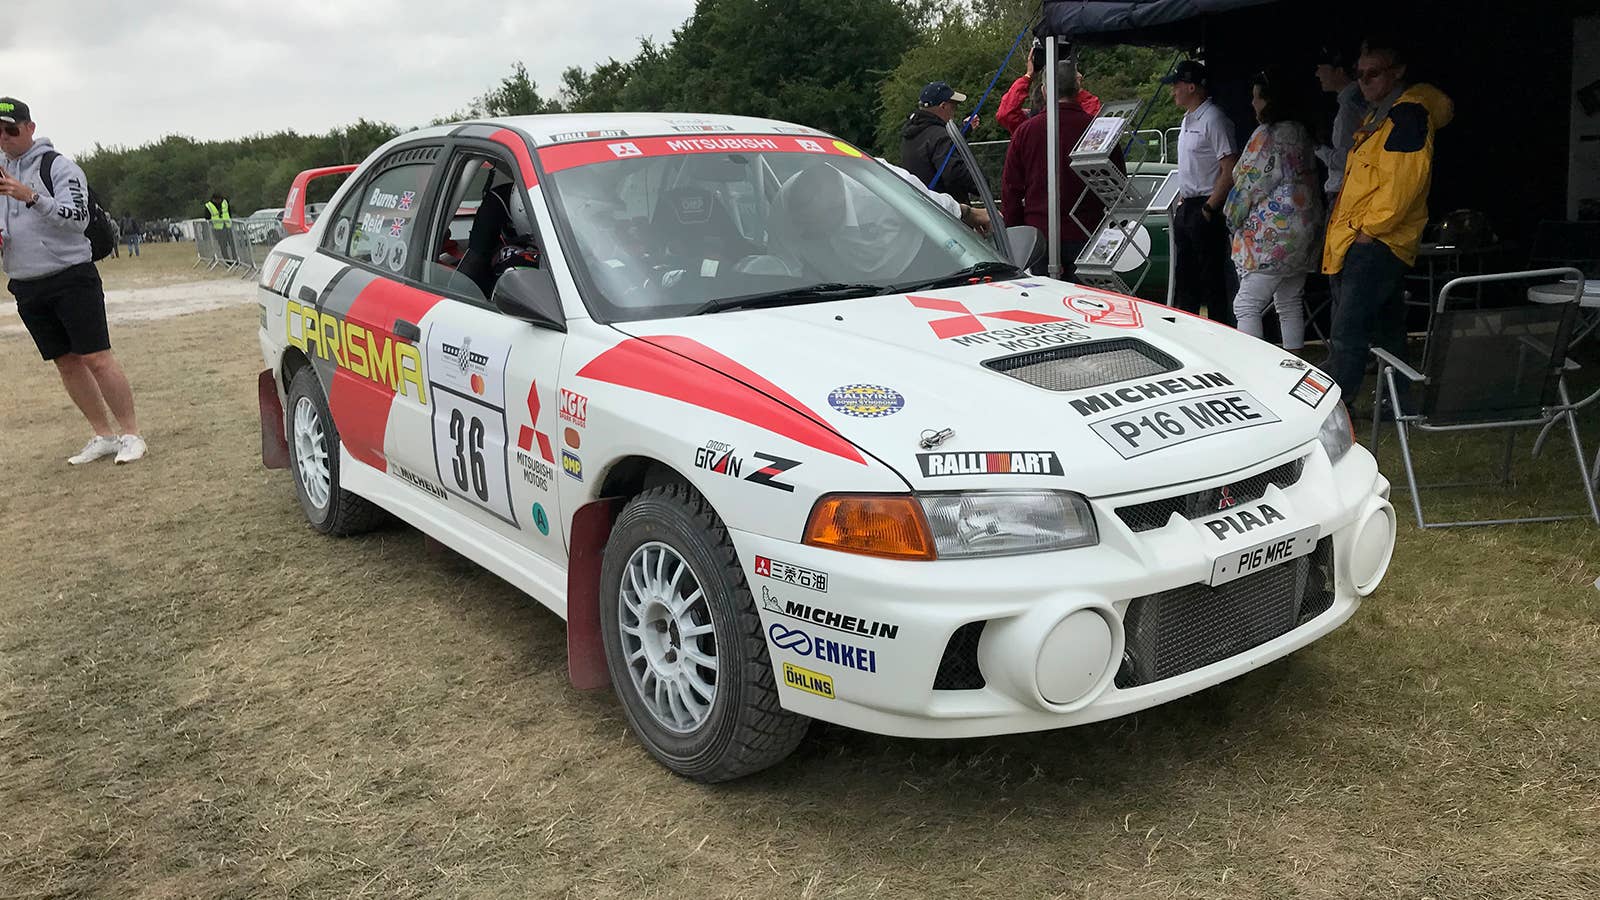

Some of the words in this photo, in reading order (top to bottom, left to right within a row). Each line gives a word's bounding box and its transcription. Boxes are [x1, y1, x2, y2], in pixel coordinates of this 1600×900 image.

[667, 138, 778, 151] MITSUBISHI
[370, 188, 398, 209] Burns
[361, 213, 385, 234] Reid
[951, 320, 1090, 347] MITSUBISHI
[998, 331, 1092, 352] MOTORS
[287, 300, 427, 405] CARISMA
[561, 390, 586, 419] NGK
[1069, 371, 1234, 416] MICHELIN
[1111, 411, 1186, 448] P16
[1179, 396, 1262, 430] MRE
[449, 408, 489, 502] 36
[516, 451, 554, 481] MITSUBISHI
[563, 456, 581, 475] OMP
[694, 447, 743, 478] GRAN
[743, 451, 803, 493] Z
[400, 465, 449, 501] MICHELIN
[523, 468, 548, 492] MOTORS
[536, 508, 547, 529] A
[1204, 504, 1286, 541] PIAA
[1238, 548, 1263, 574] P16
[1264, 537, 1296, 564] MRE
[772, 562, 826, 591] 三菱石油
[785, 600, 899, 640] MICHELIN
[814, 637, 877, 673] ENKEI
[786, 665, 832, 695] ÖHLINS
